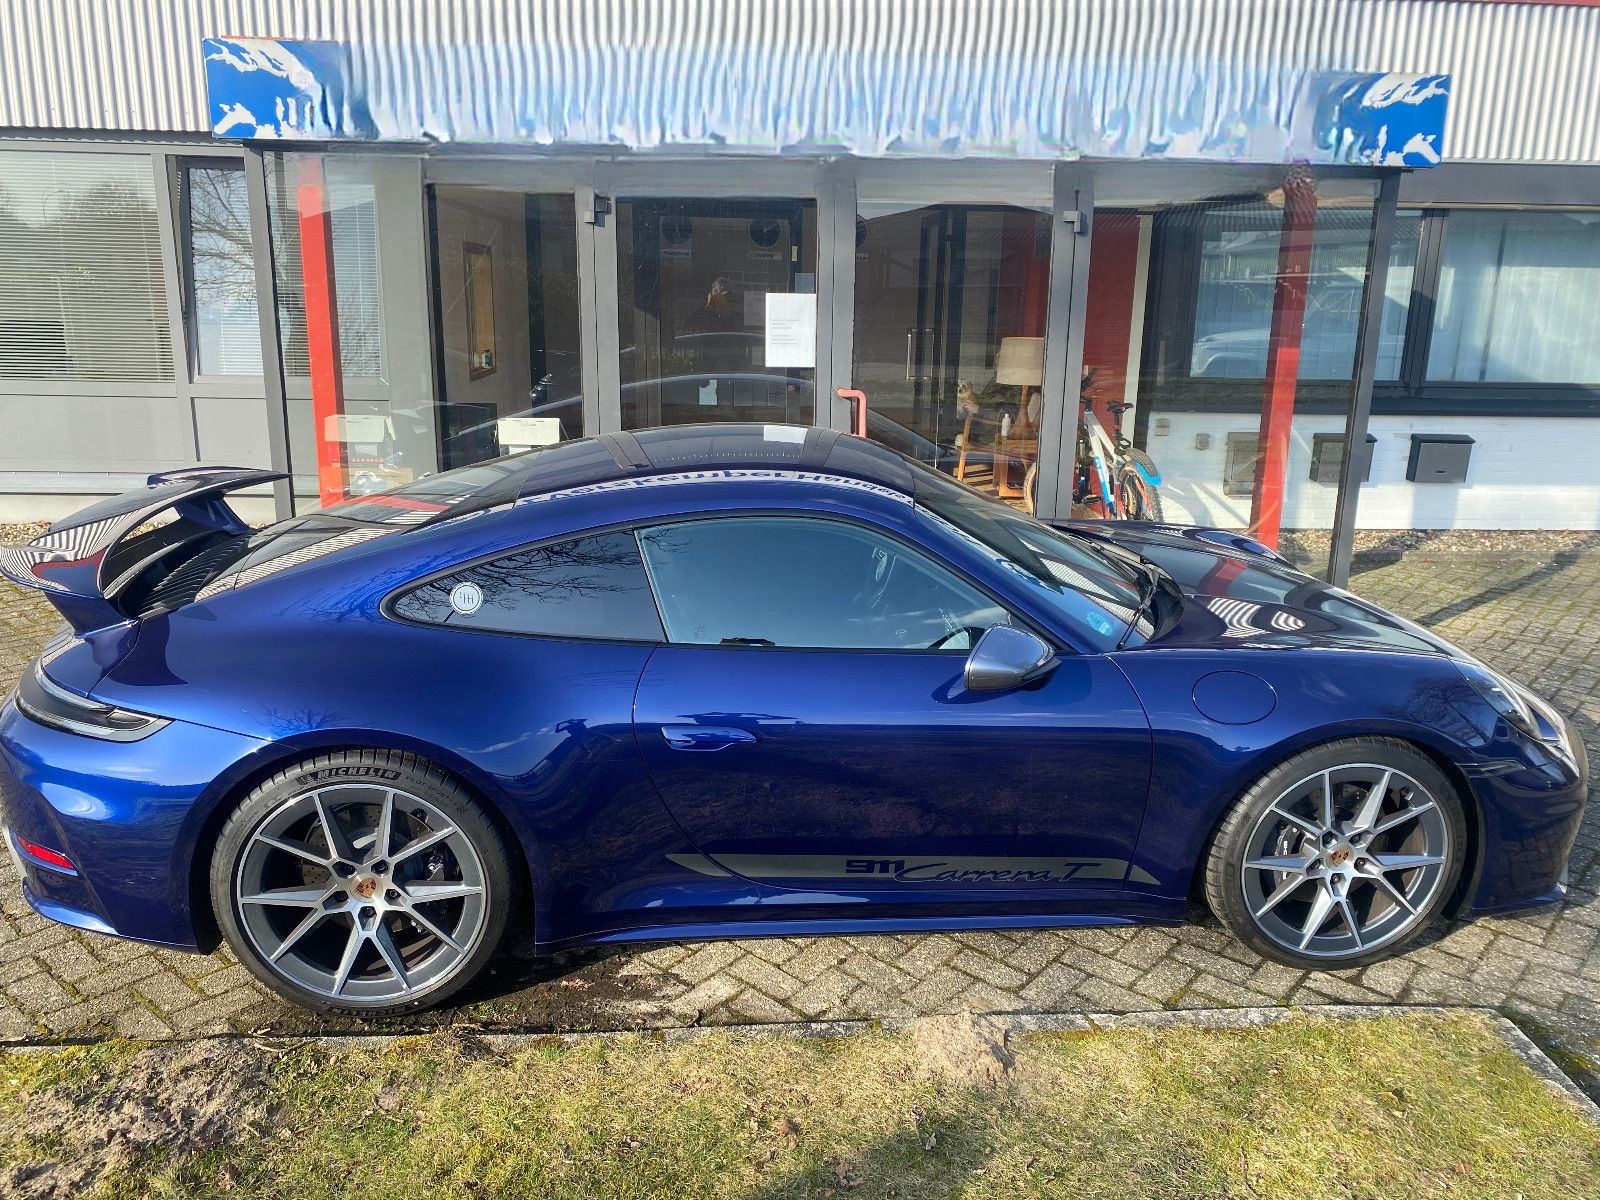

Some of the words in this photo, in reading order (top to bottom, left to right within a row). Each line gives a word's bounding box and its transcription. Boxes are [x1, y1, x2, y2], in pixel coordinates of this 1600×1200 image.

[317, 766, 398, 780] MICHELIN
[845, 859, 906, 874] 911
[895, 862, 1054, 882] Carrera
[1060, 862, 1103, 882] T
